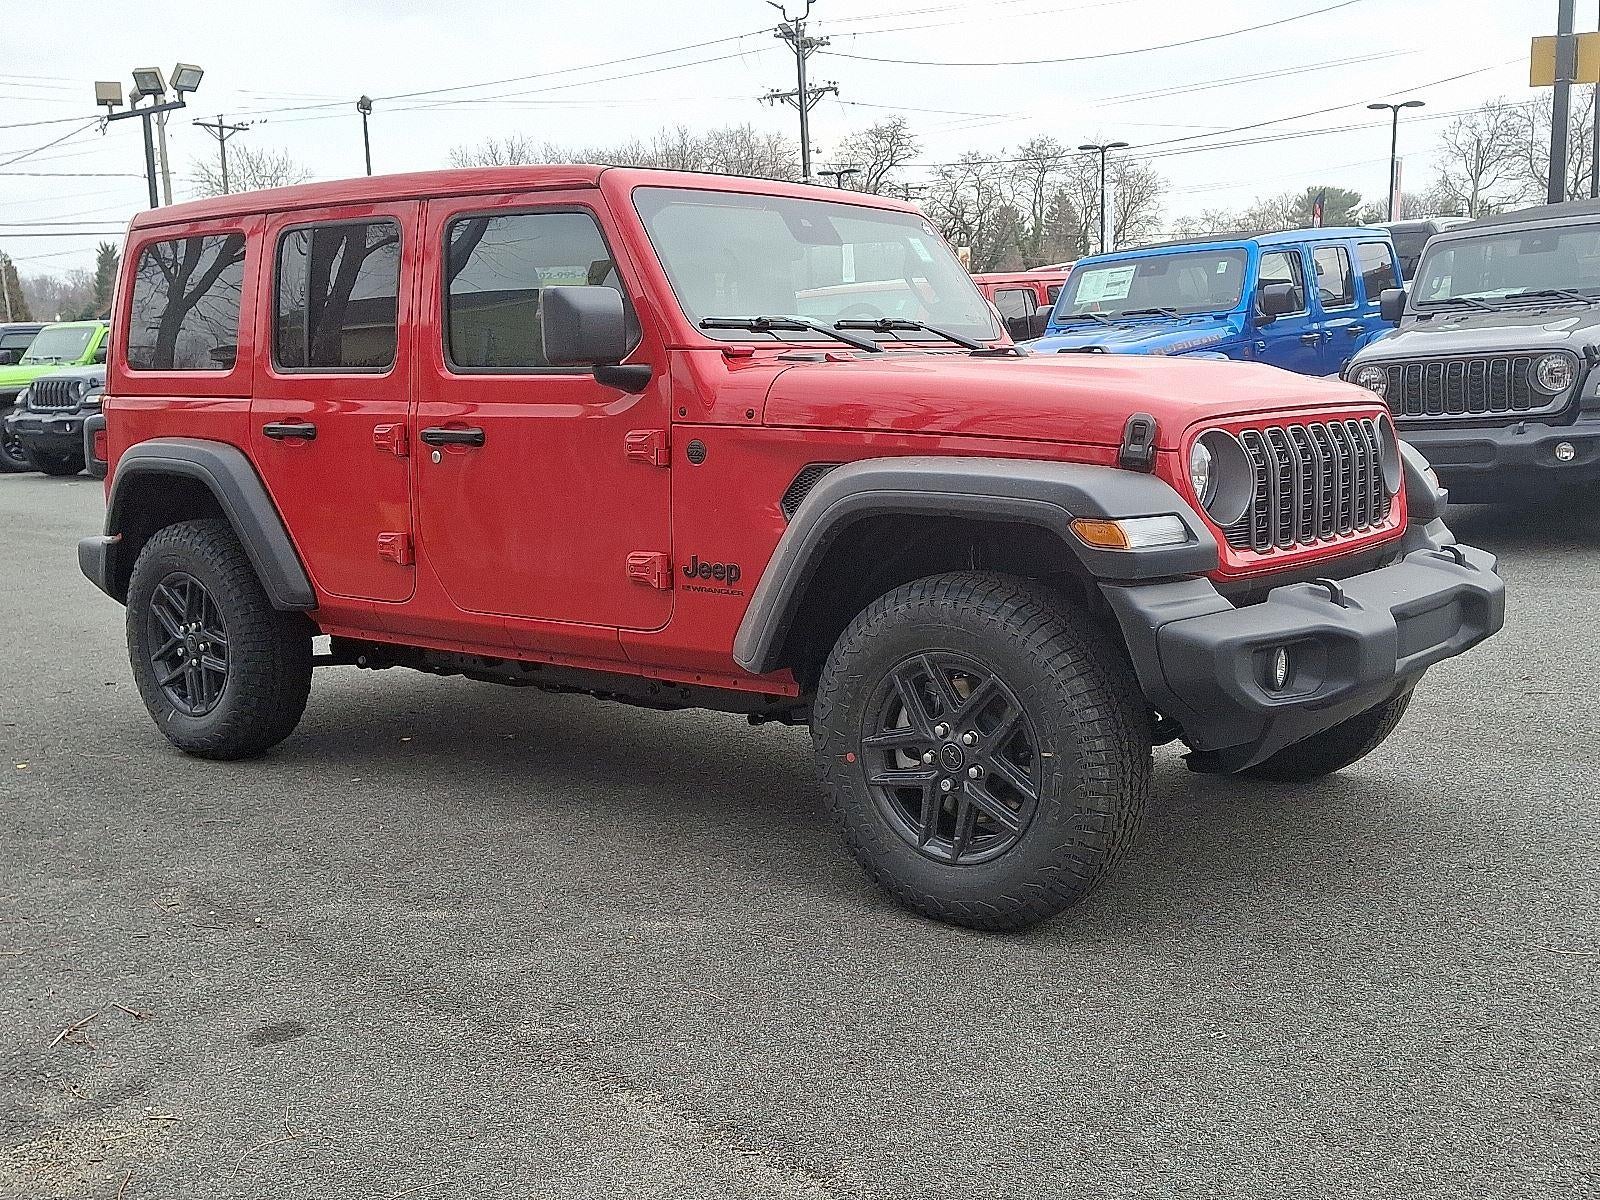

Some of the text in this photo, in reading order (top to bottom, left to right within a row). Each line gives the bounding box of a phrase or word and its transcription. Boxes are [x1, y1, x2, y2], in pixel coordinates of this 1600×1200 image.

[1151, 334, 1222, 355] RUBICON
[682, 555, 741, 586] Jeep
[691, 585, 744, 597] WRANGLER
